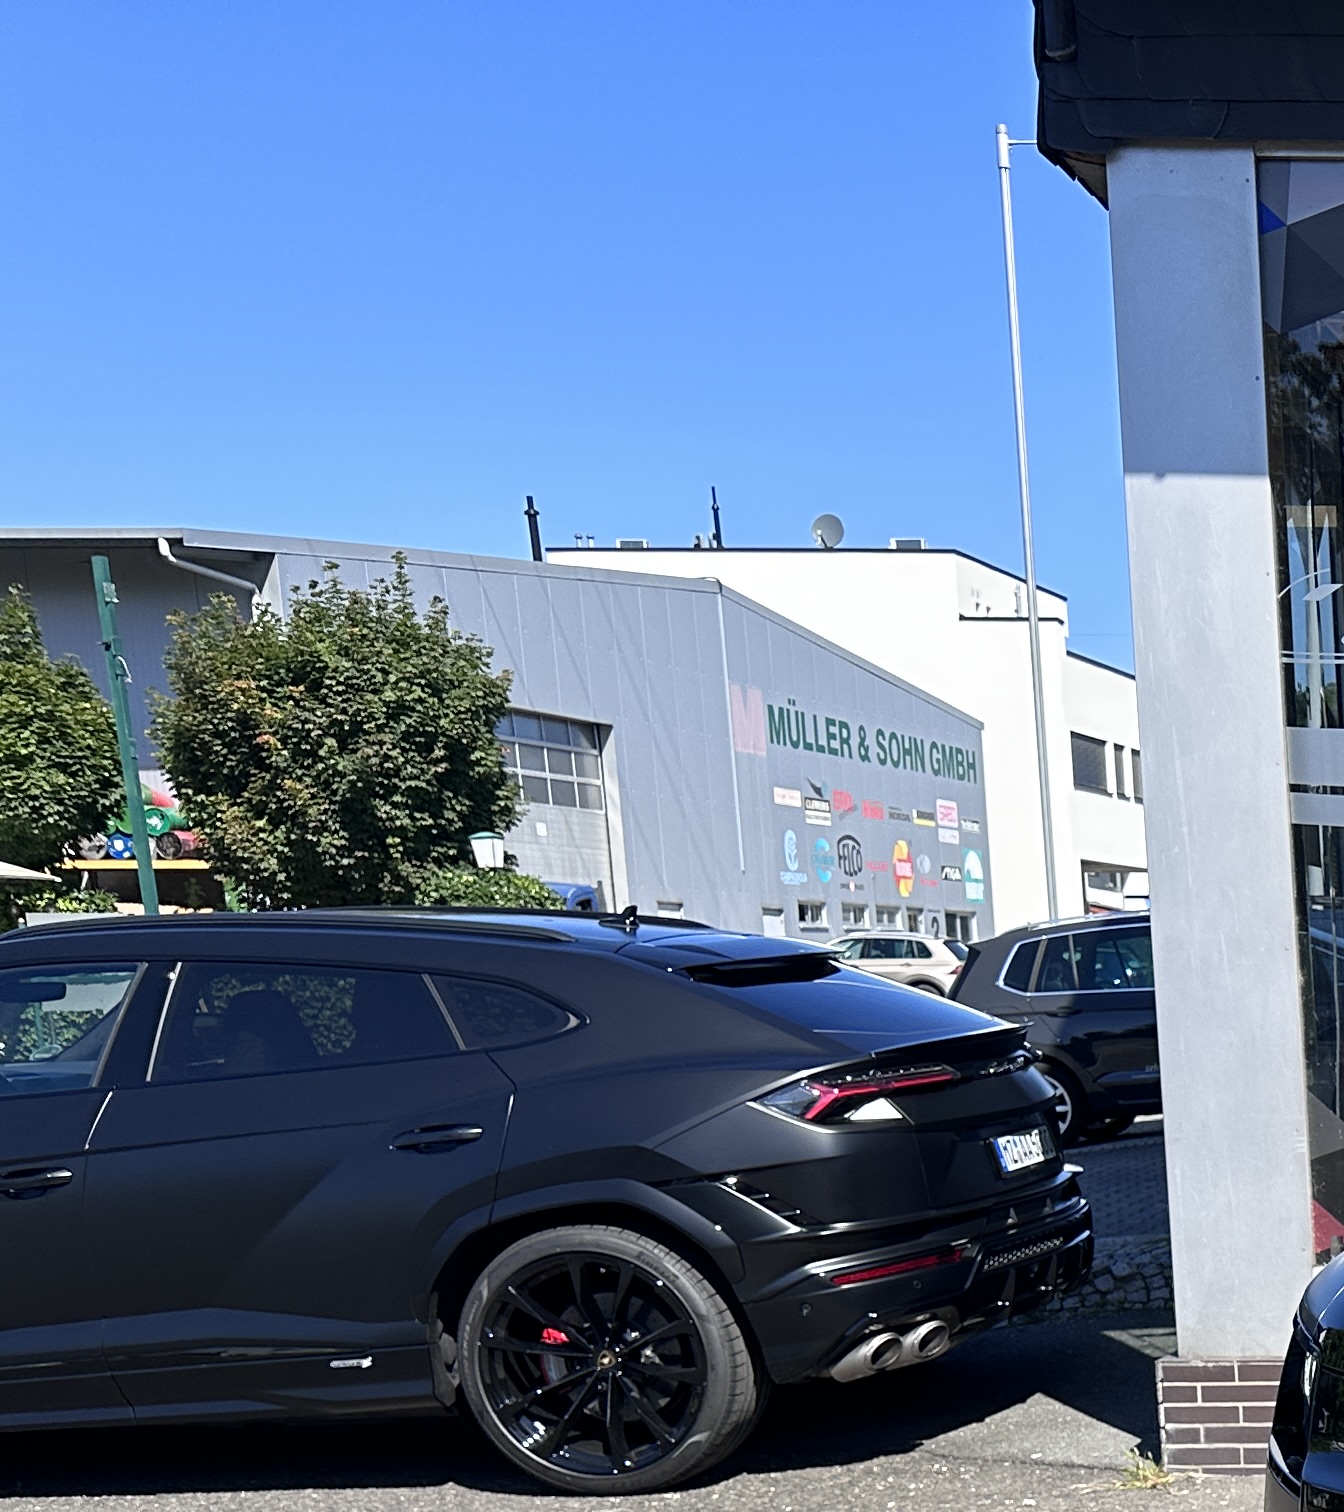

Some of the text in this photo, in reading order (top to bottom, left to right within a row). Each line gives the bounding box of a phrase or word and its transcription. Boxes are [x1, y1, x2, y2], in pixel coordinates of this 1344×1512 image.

[766, 698, 978, 785] MÜLLER & SOHN GMBH
[836, 834, 864, 878] FELCO
